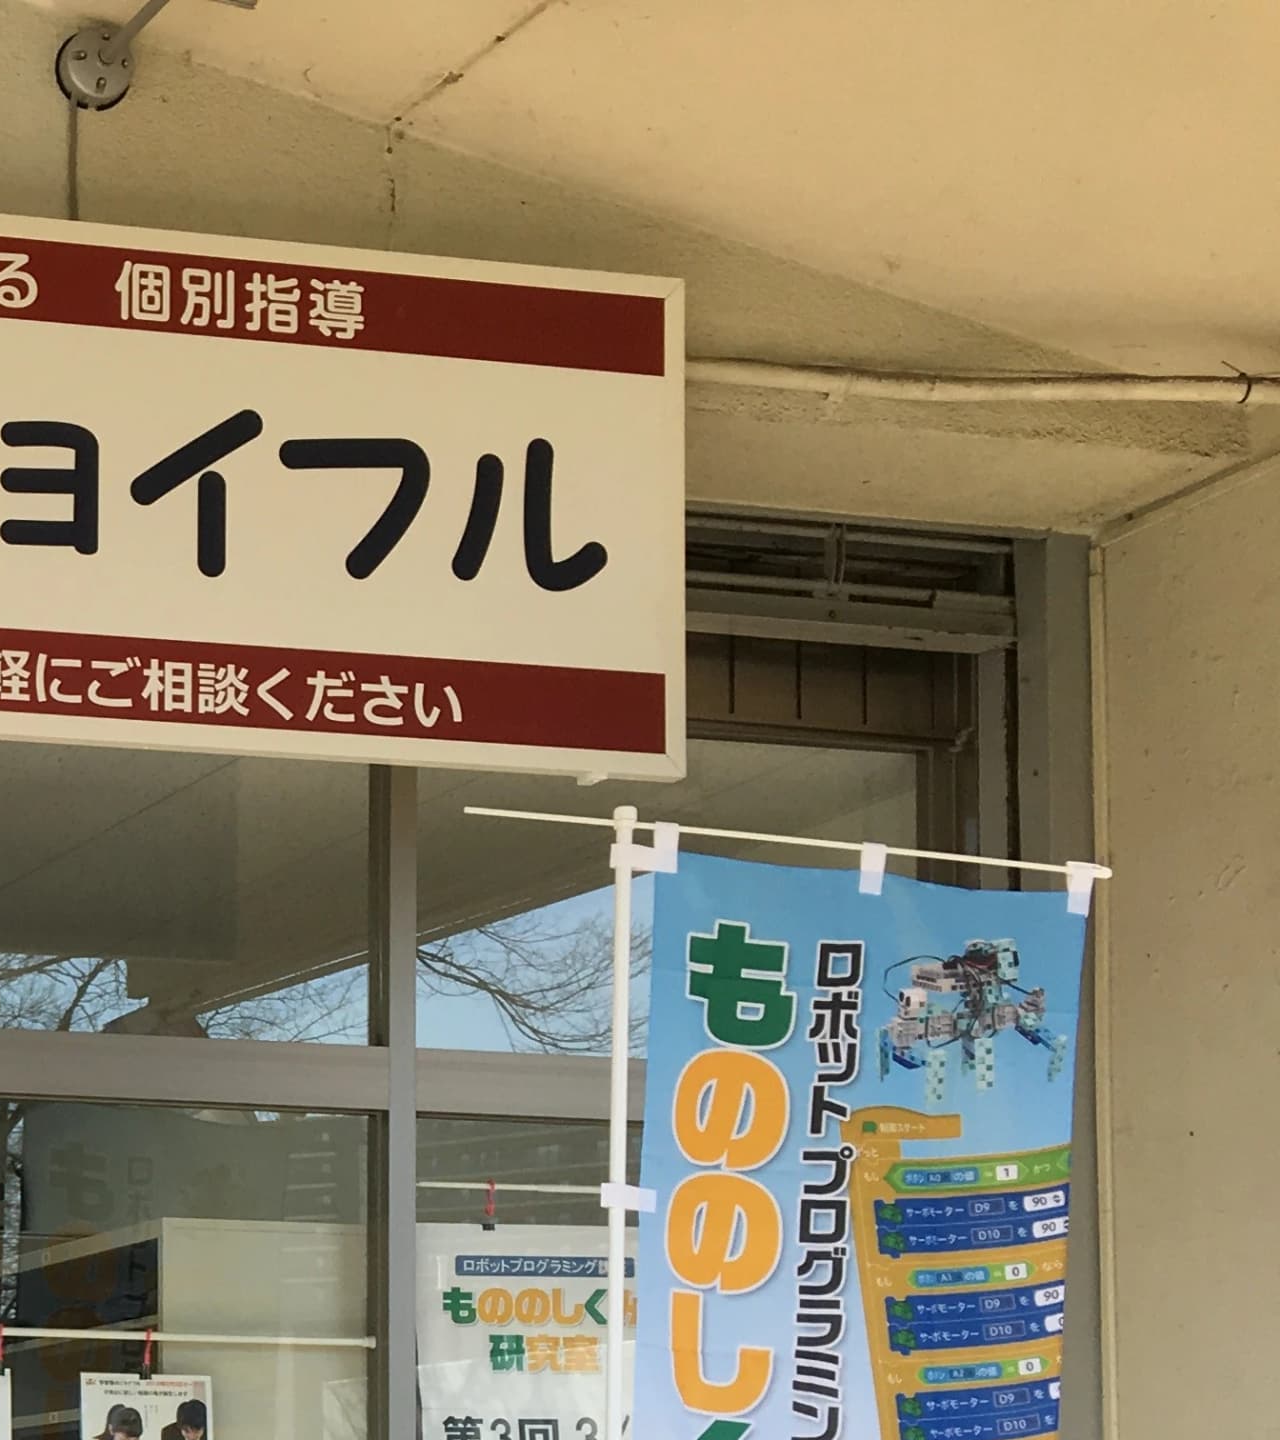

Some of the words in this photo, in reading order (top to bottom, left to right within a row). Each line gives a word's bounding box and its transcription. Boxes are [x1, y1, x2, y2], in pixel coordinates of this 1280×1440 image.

[115, 258, 367, 341] 個別指導
[974, 1202, 991, 1213] D9
[1031, 1196, 1048, 1207] 90
[978, 1230, 1001, 1241] D10
[1041, 1222, 1057, 1233] 90
[463, 1259, 608, 1275] ロボットプログラミング
[984, 1298, 1001, 1309] D9
[1043, 1289, 1060, 1301] 90
[990, 1325, 1013, 1336] D10
[489, 1334, 601, 1374] 研究室
[999, 1393, 1016, 1405] D9
[1003, 1420, 1027, 1432] D10
